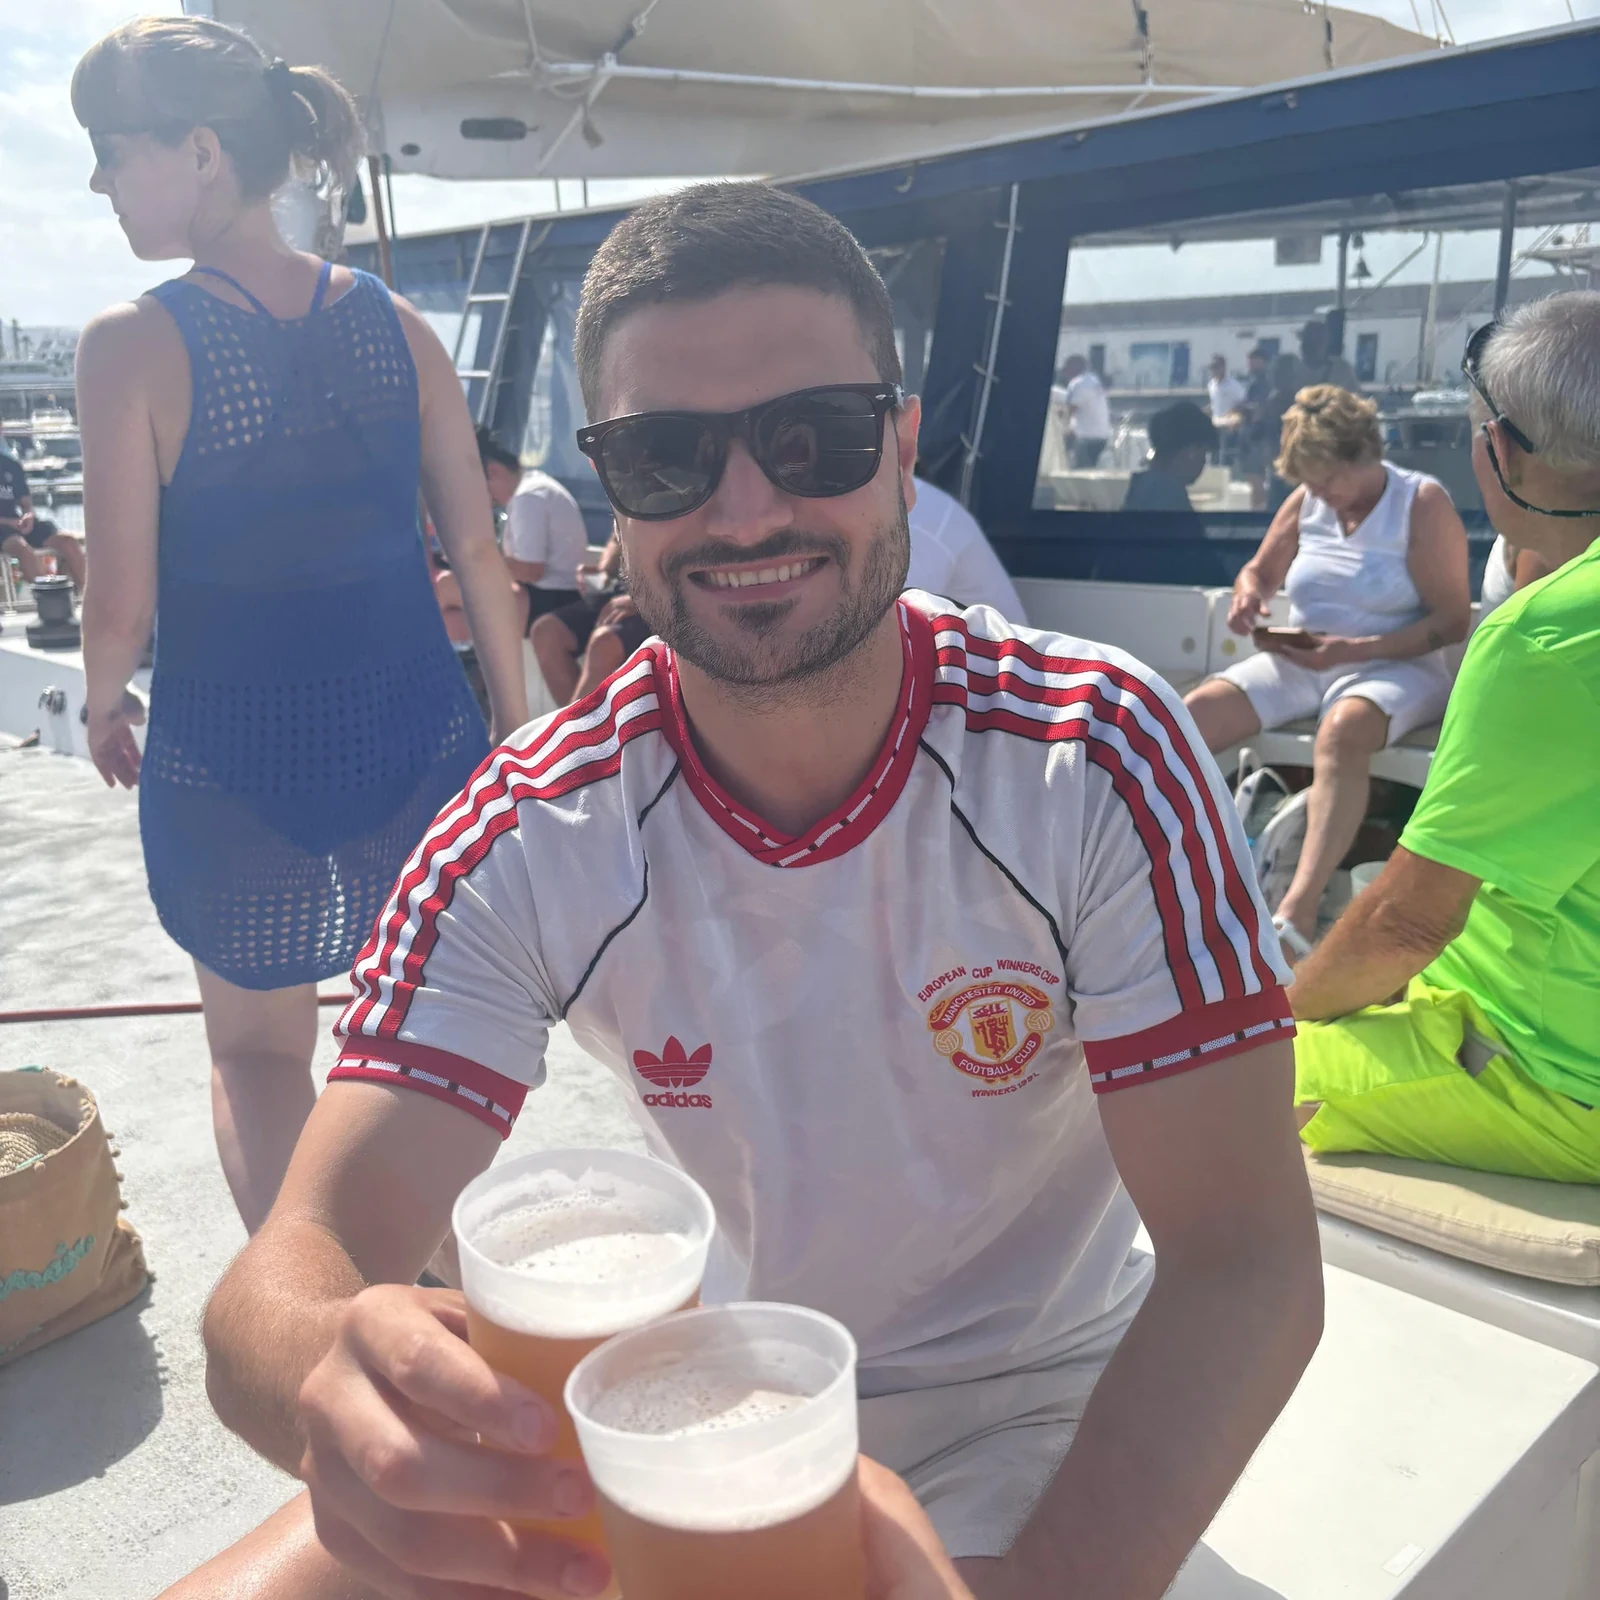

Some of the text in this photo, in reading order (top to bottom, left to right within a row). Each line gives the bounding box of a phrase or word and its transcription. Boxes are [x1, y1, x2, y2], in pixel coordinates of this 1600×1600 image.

[917, 959, 1060, 1002] EUROPEAN CUP WINNERS CUP
[942, 986, 1036, 1024] MANCHESTER UNITED
[959, 1039, 1037, 1076] FOOTBALL CLUB
[643, 1092, 713, 1109] adidas
[971, 1084, 1018, 1098] WINNERS
